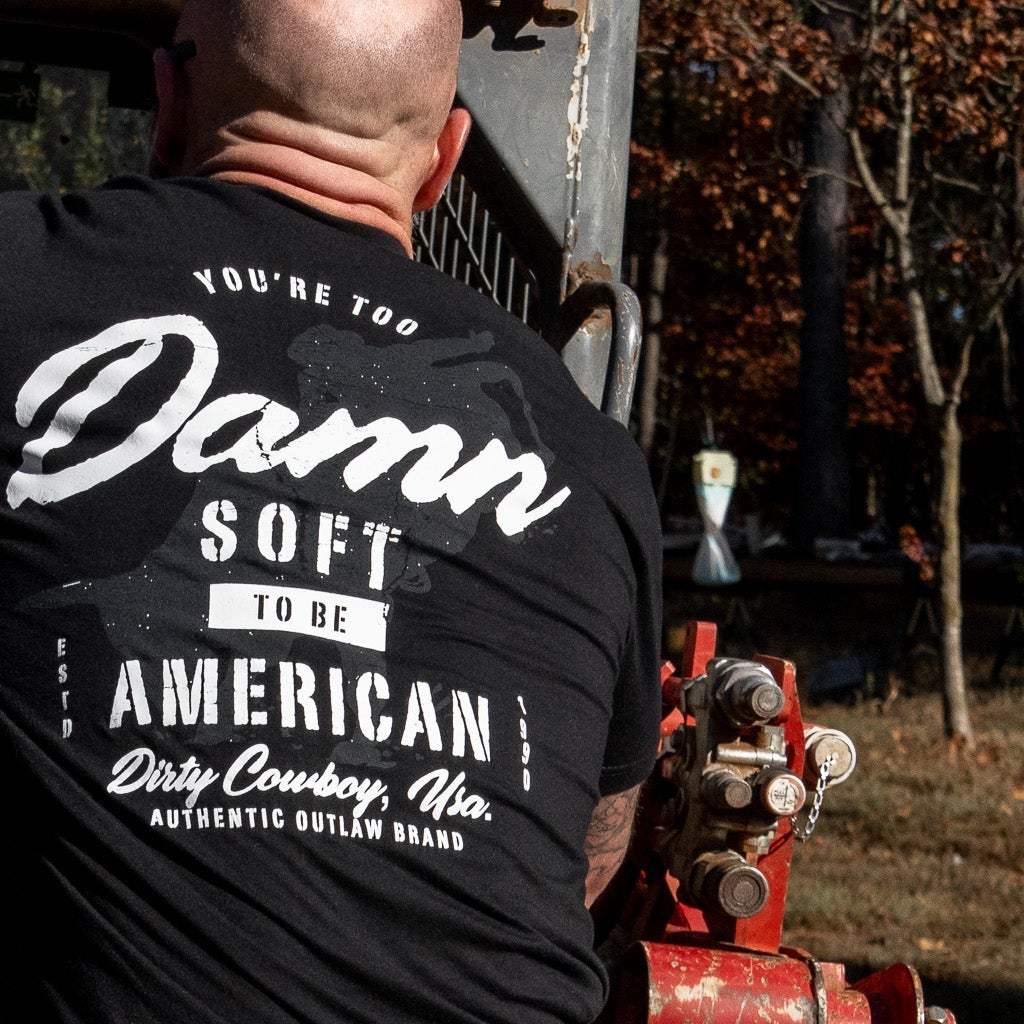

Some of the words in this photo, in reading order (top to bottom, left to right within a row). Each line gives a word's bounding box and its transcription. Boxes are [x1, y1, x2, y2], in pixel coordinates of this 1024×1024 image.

[192, 266, 331, 307] YOU'RE
[351, 294, 419, 336] TOO
[6, 313, 572, 537] Damn
[200, 499, 403, 591] SOFT
[253, 594, 293, 622] TO
[311, 600, 348, 634] BE
[109, 657, 492, 763] AMERICAN
[517, 695, 531, 792] 1990
[106, 747, 220, 809] Dirty
[222, 743, 390, 819] Cowboy,
[407, 768, 492, 821] Usa.
[150, 806, 285, 830] AUTHENTIC
[295, 809, 383, 840] OUTLAW
[393, 821, 464, 851] BRAND
